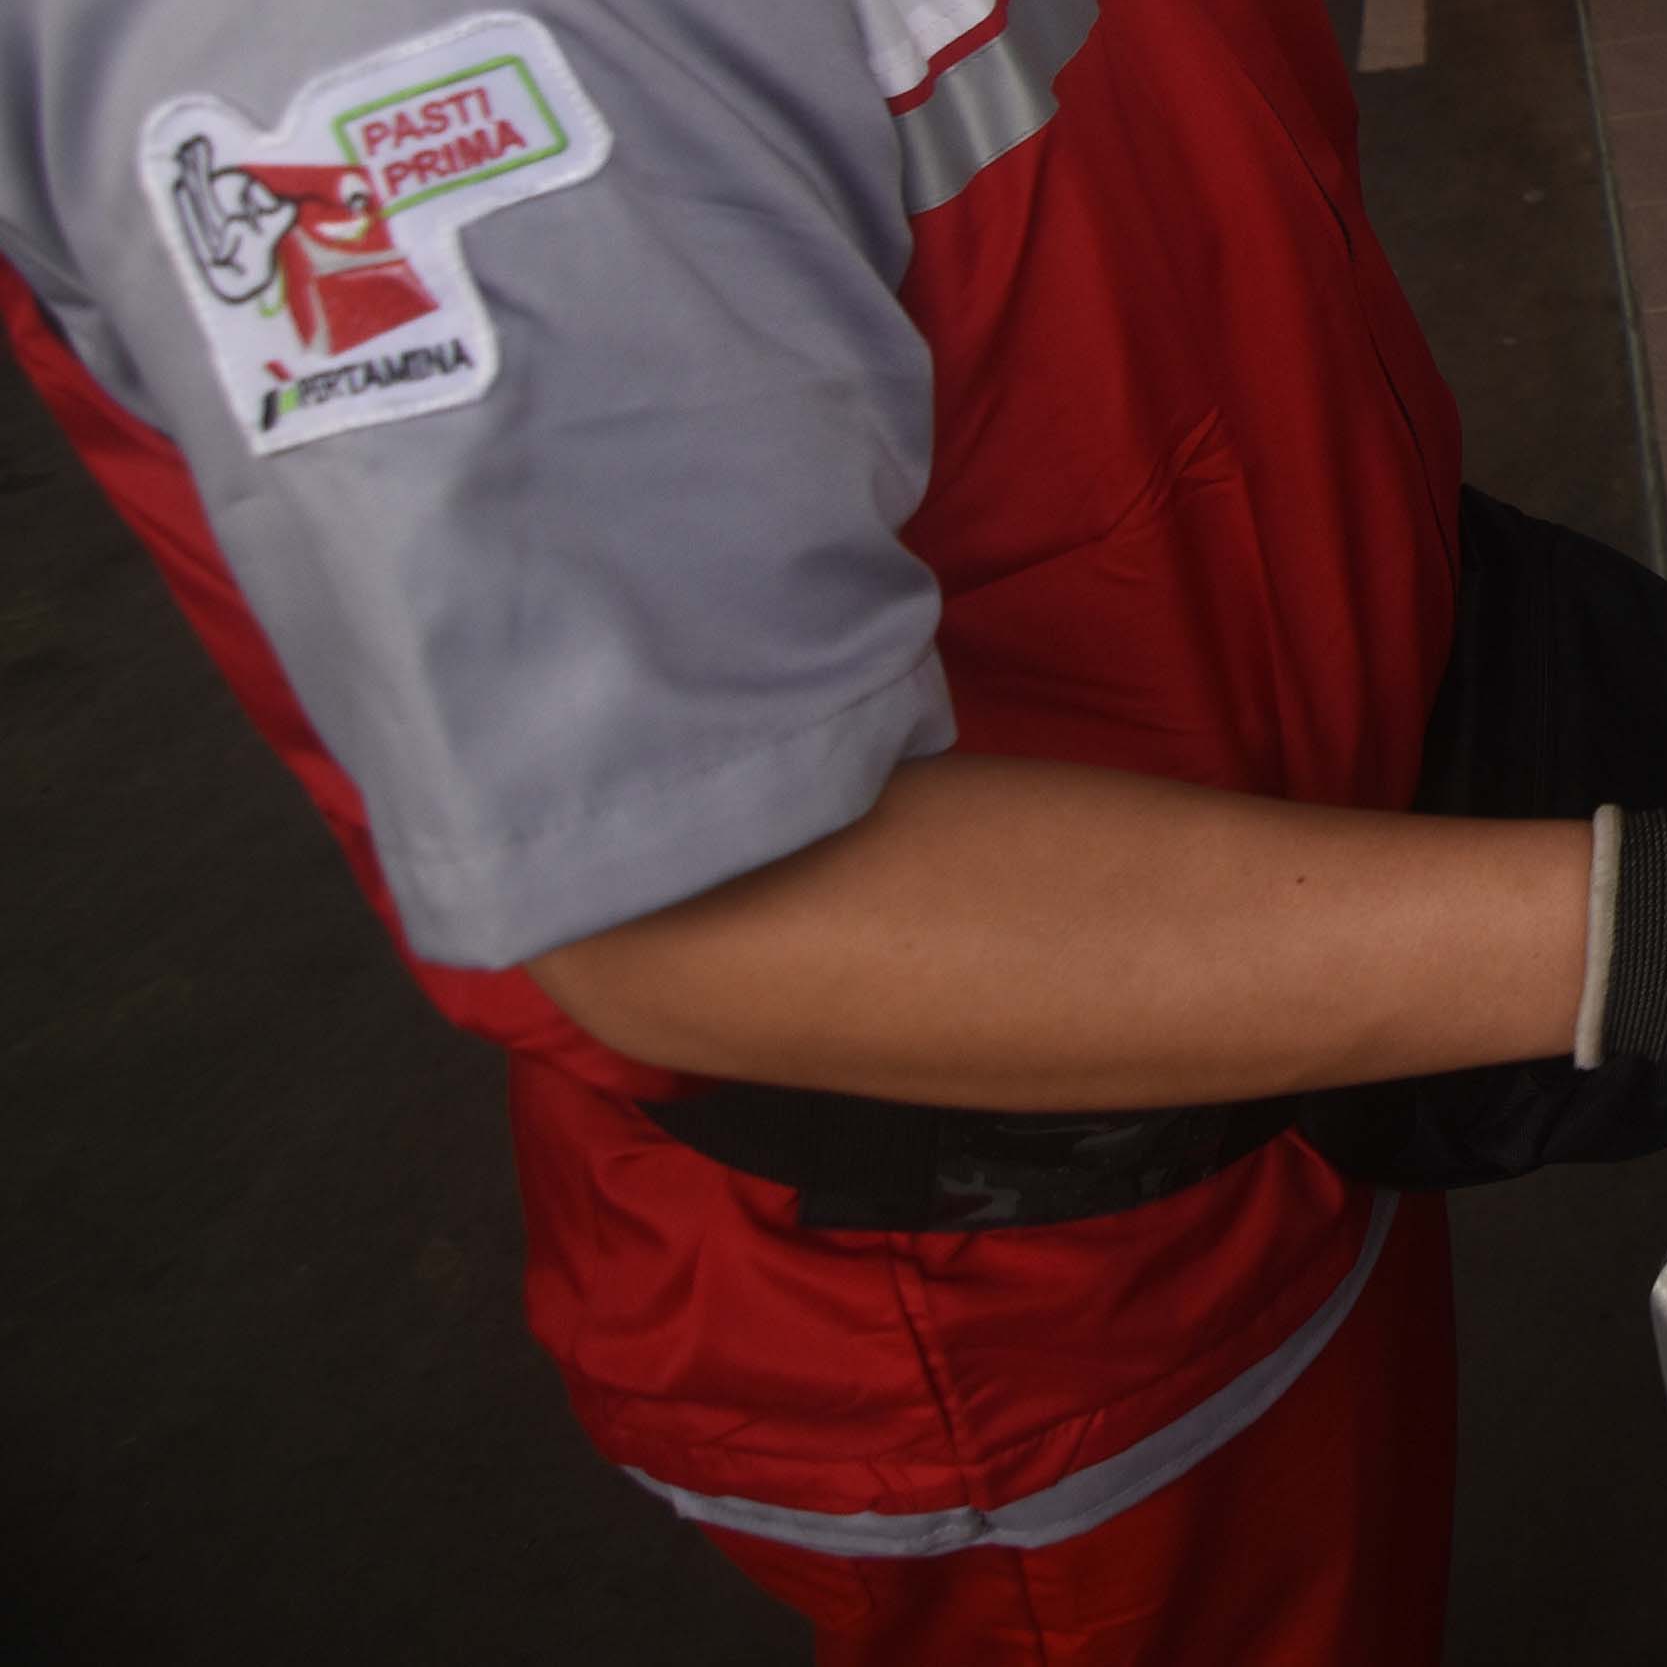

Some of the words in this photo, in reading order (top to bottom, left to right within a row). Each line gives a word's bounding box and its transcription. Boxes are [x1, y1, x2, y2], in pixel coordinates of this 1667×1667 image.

[362, 87, 490, 155] PASTI
[382, 122, 527, 198] PRIMA
[297, 339, 474, 405] PERTAMINA
